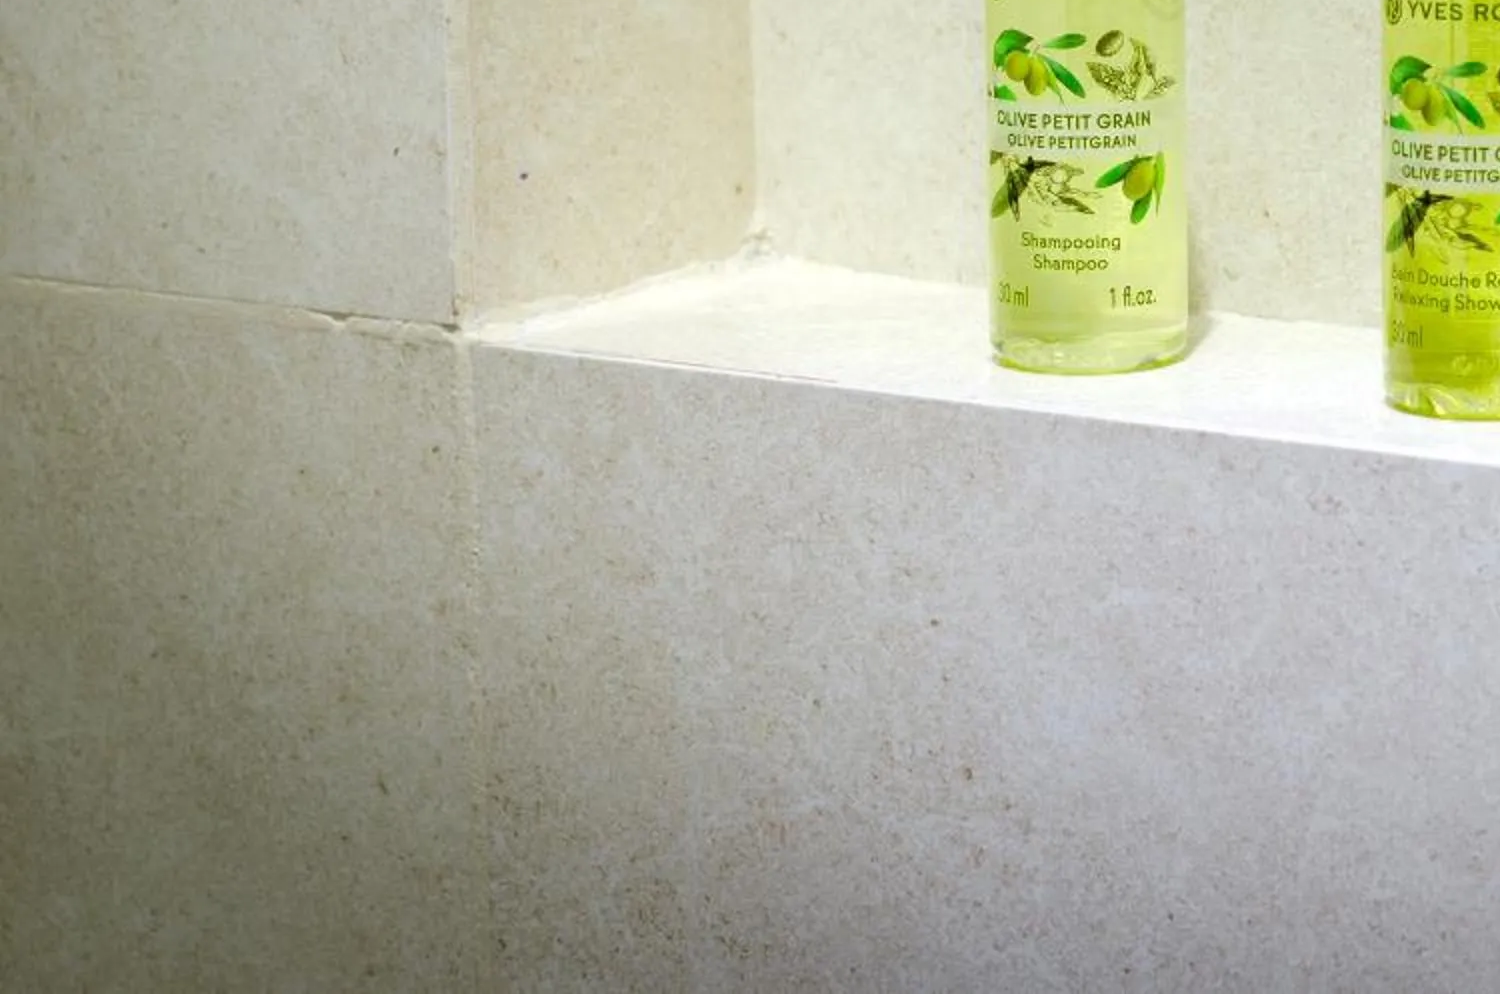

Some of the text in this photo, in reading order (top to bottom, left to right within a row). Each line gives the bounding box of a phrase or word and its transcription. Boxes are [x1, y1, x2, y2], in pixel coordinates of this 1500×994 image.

[1408, 0, 1463, 21] YVES
[997, 109, 1151, 130] OLIVE PETIT GRAIN
[1007, 133, 1137, 150] OLIVE PETITGRAIN
[1391, 139, 1433, 161] OLIVE
[1437, 144, 1489, 163] PETIT
[1402, 164, 1441, 182] OLIVE
[1021, 232, 1121, 250] Shampooing
[1033, 254, 1109, 274] Shampoo
[1418, 269, 1481, 288] Douche
[1013, 286, 1029, 308] ml
[1109, 287, 1117, 309] 1
[1407, 325, 1423, 348] ml
